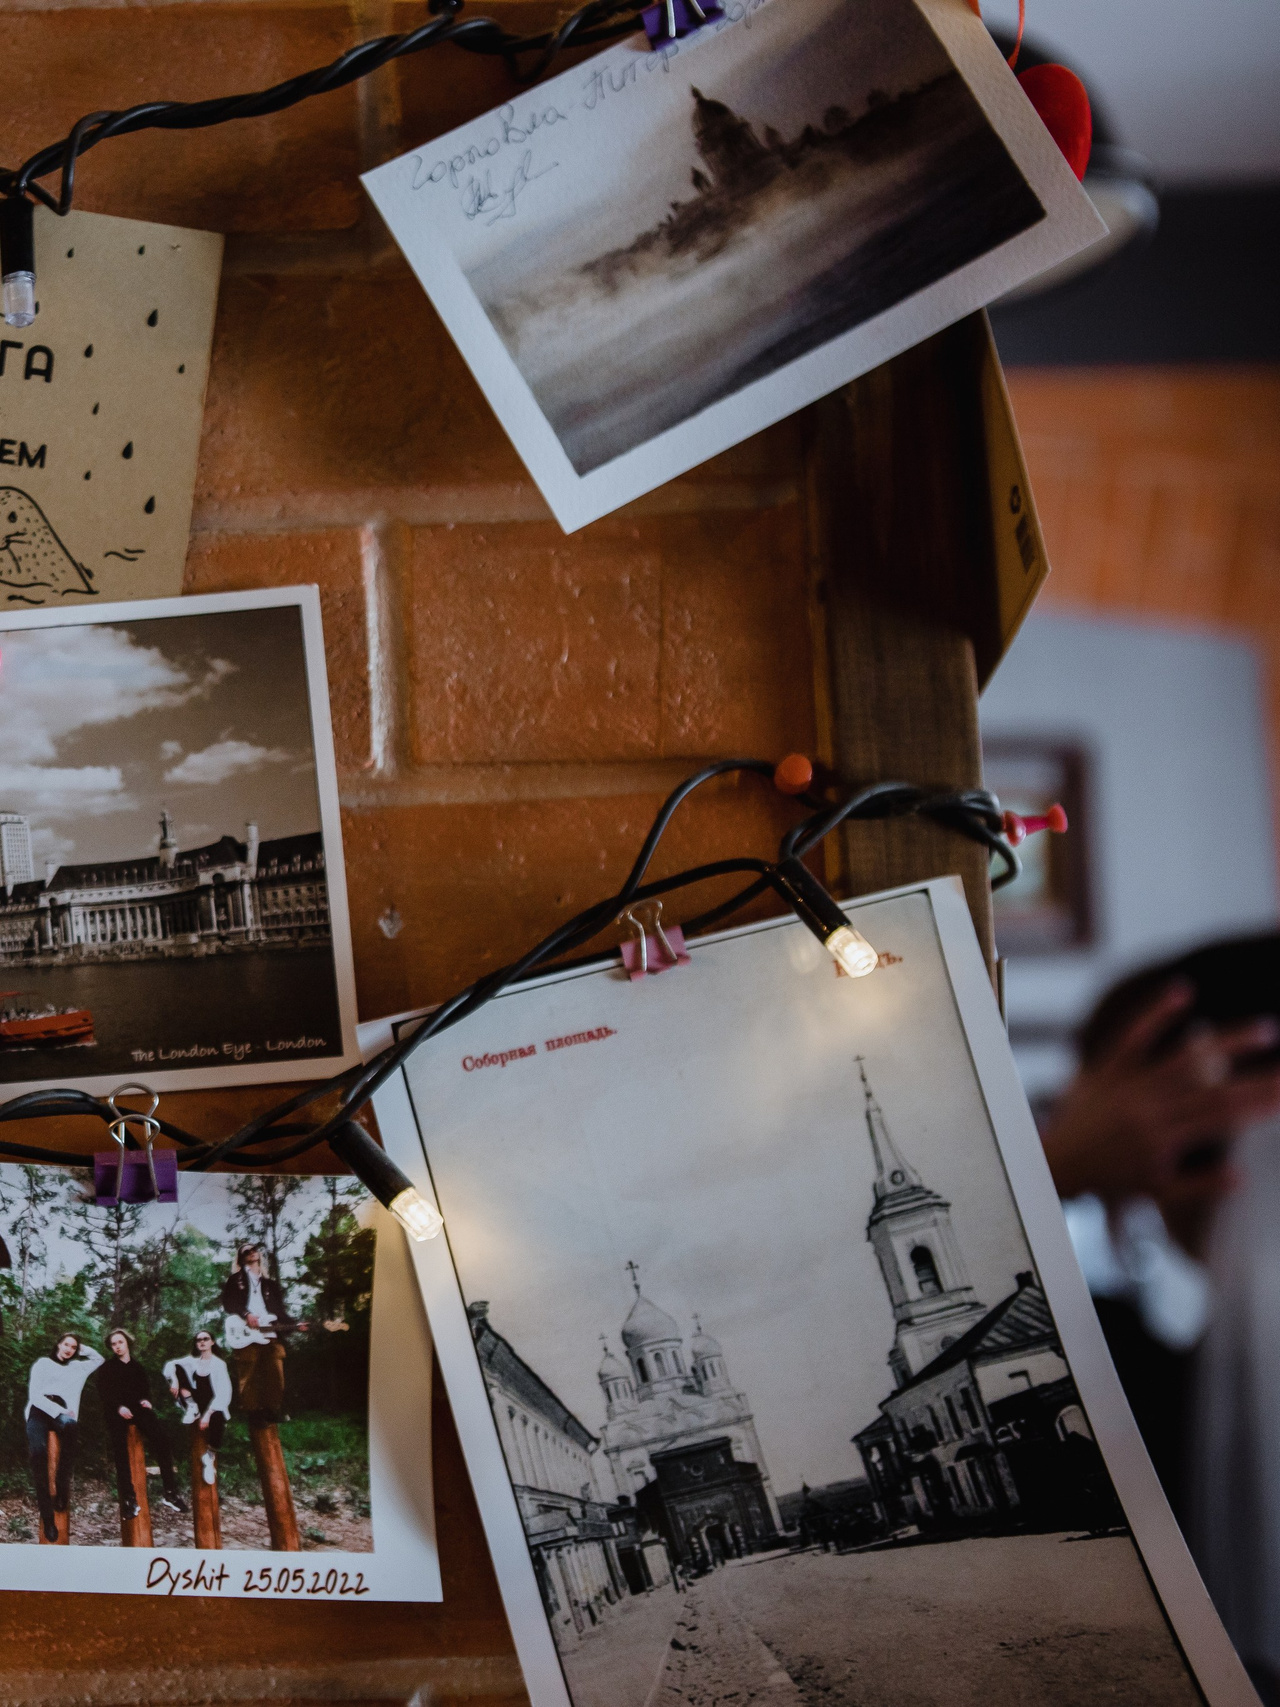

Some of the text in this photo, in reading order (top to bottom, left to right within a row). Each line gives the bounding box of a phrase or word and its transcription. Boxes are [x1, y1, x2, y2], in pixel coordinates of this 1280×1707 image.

[131, 1049, 155, 1062] The
[158, 1044, 219, 1060] London
[223, 1042, 252, 1060] Eye
[266, 1036, 327, 1051] London
[461, 1044, 537, 1072] Соборная
[146, 1557, 370, 1595] Dyshit 25.05.2022
